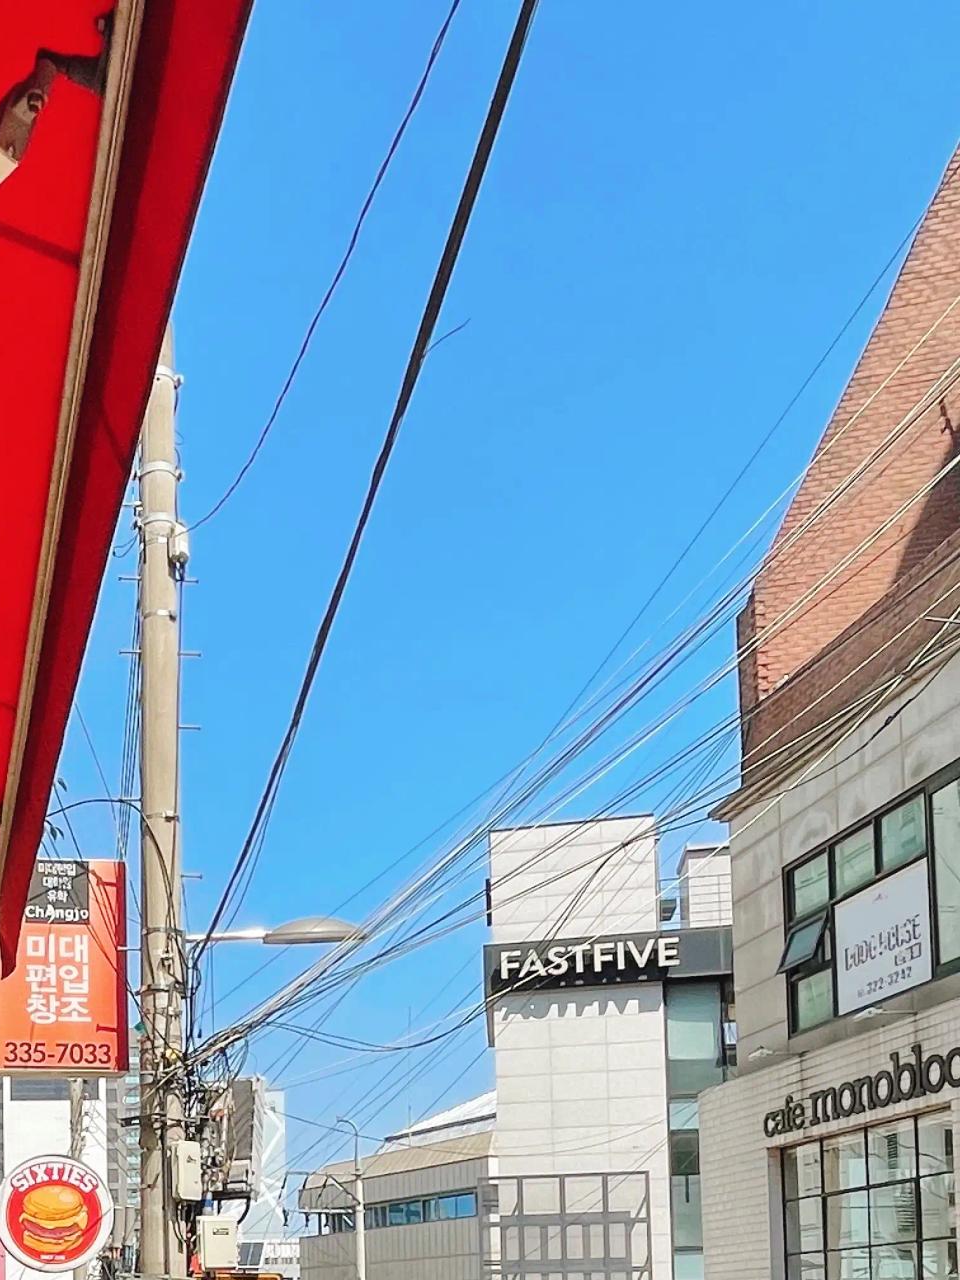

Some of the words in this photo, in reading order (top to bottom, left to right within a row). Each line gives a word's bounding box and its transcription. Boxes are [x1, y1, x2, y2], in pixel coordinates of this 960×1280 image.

[26, 933, 89, 964] 미대
[500, 937, 681, 980] FASTFIVE
[25, 963, 89, 993] 편입
[26, 993, 92, 1024] 창조
[4, 1042, 111, 1064] 335-7033
[763, 1095, 805, 1138] cafe
[11, 1163, 100, 1194] SIXTIES
